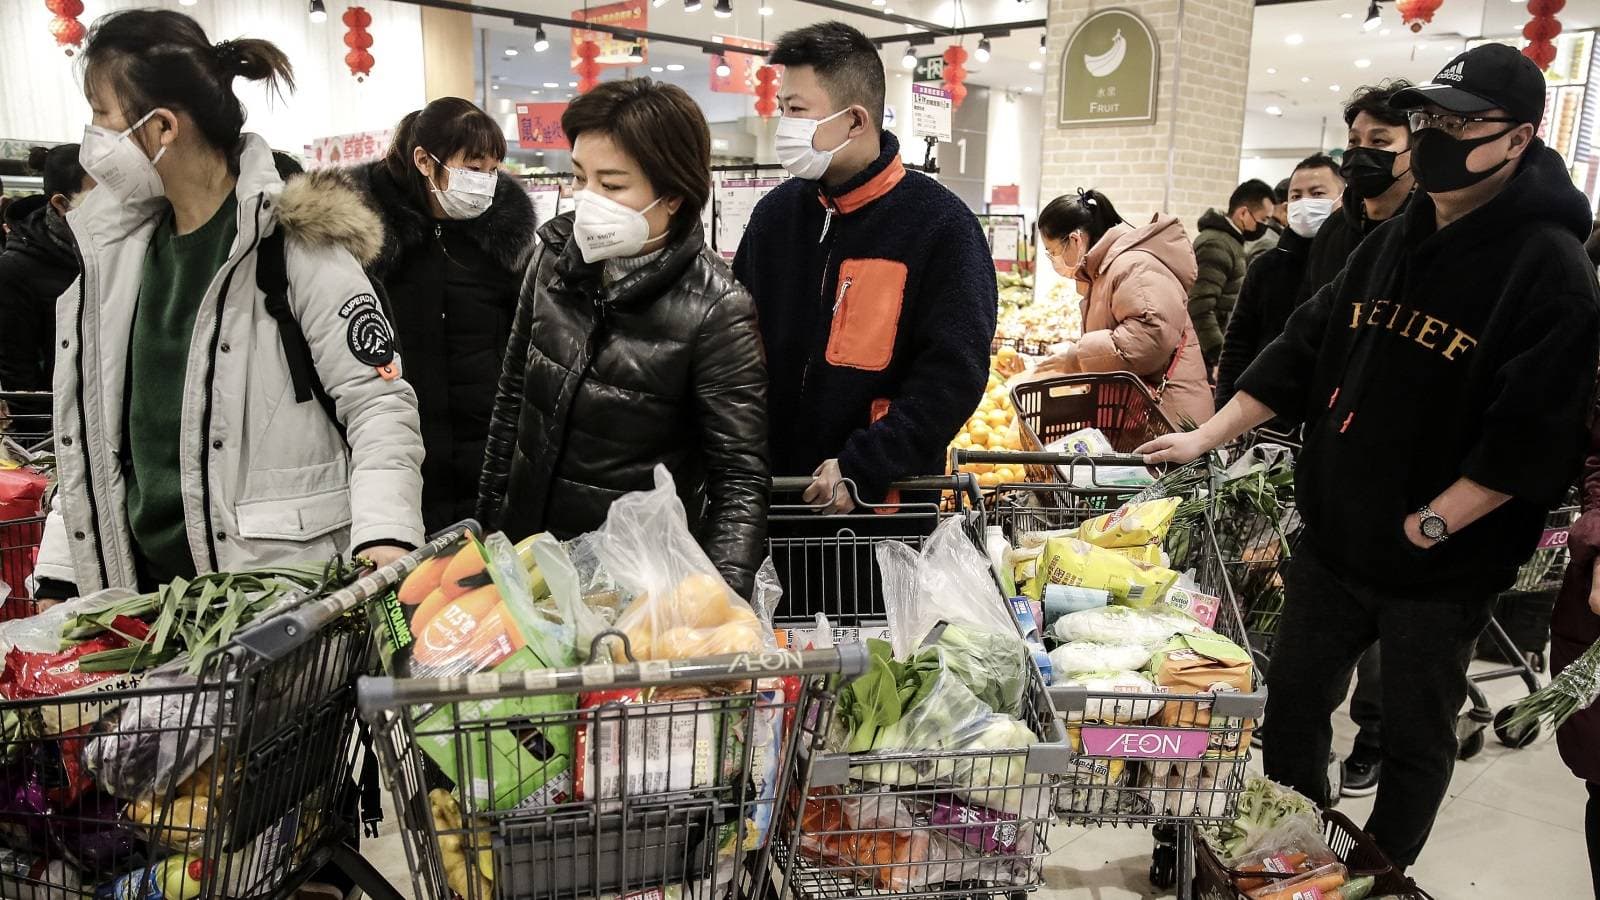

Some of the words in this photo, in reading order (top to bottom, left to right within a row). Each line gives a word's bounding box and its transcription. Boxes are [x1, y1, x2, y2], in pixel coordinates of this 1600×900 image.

[1436, 72, 1464, 82] adidas
[1096, 86, 1117, 98] 水果
[352, 313, 371, 352] EXPEDITION
[1171, 595, 1189, 605] Dettol
